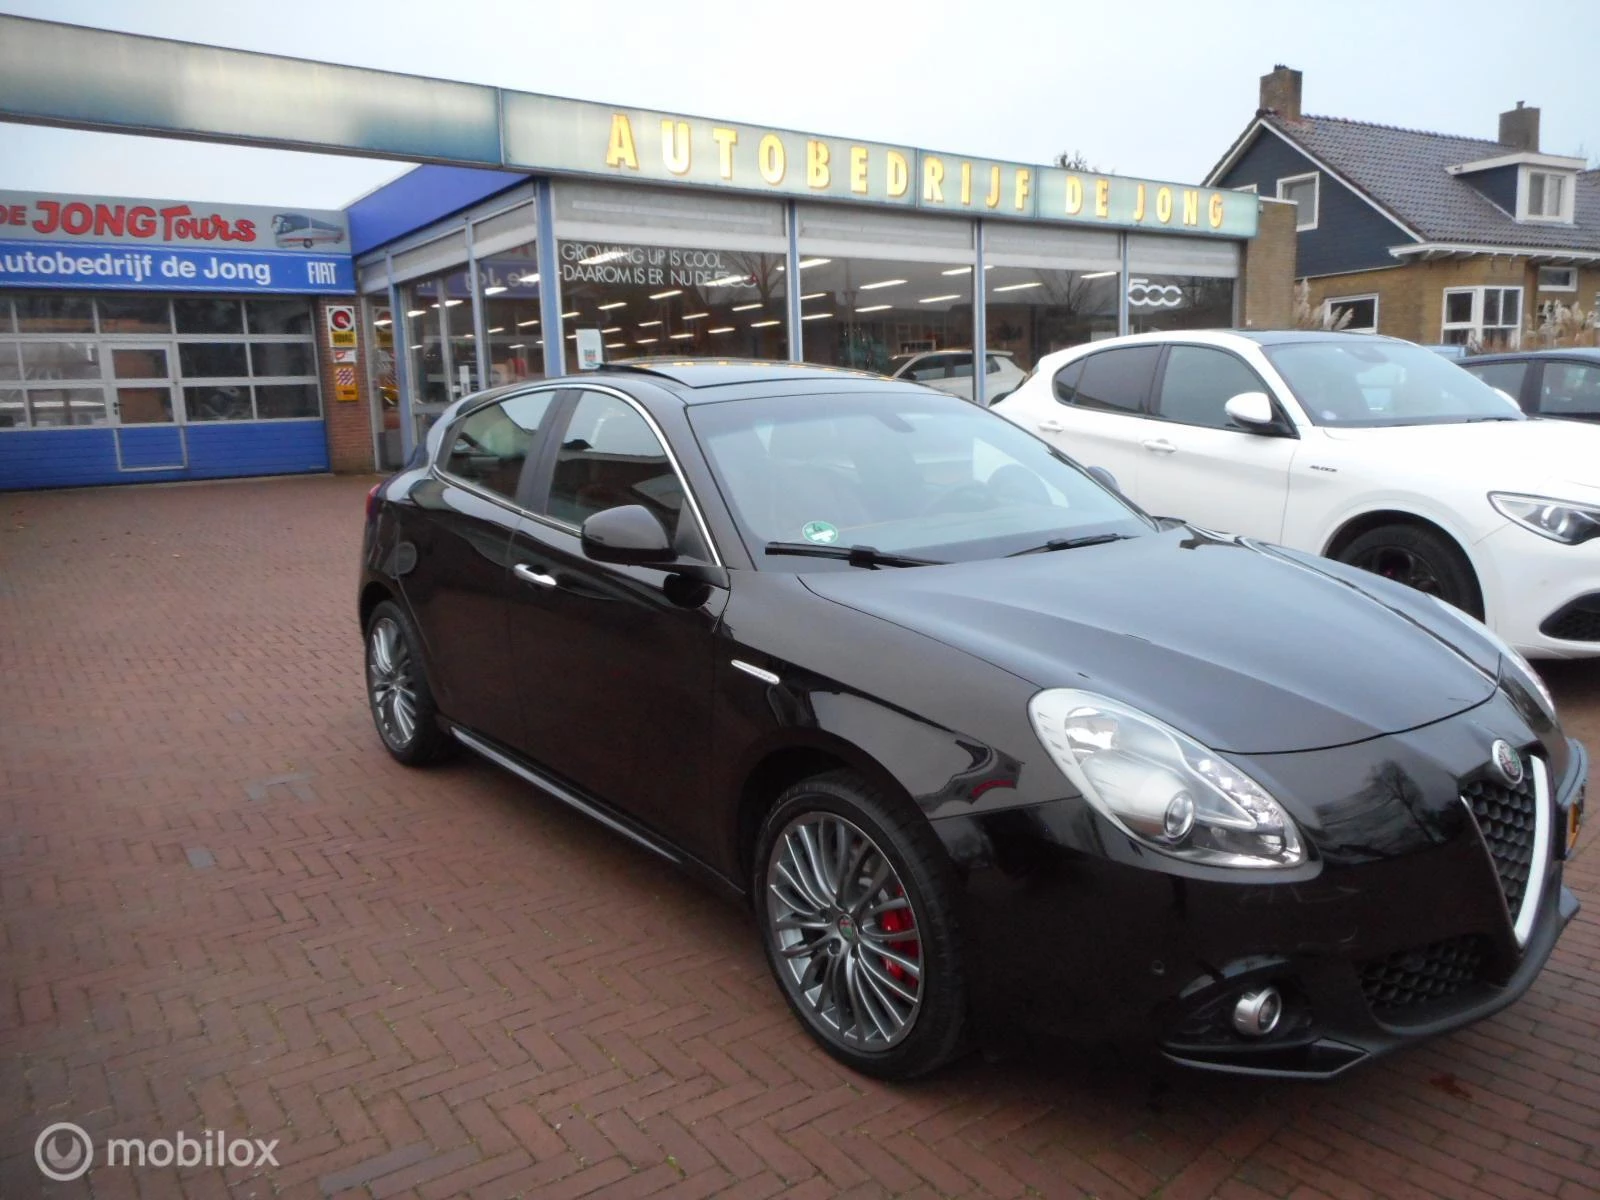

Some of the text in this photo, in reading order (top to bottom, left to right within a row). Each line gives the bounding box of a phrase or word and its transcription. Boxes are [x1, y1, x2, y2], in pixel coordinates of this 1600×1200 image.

[606, 112, 1224, 229] AUTOBEDRIJF DE JONG
[32, 200, 157, 238] JONG
[160, 204, 257, 242] Tours
[0, 251, 272, 285] utobedrijf de Jong
[648, 248, 666, 266] UP
[670, 249, 681, 267] IS
[307, 261, 337, 284] FIAT
[648, 268, 664, 285] ER
[670, 269, 692, 287] NU
[1128, 278, 1182, 307] 500
